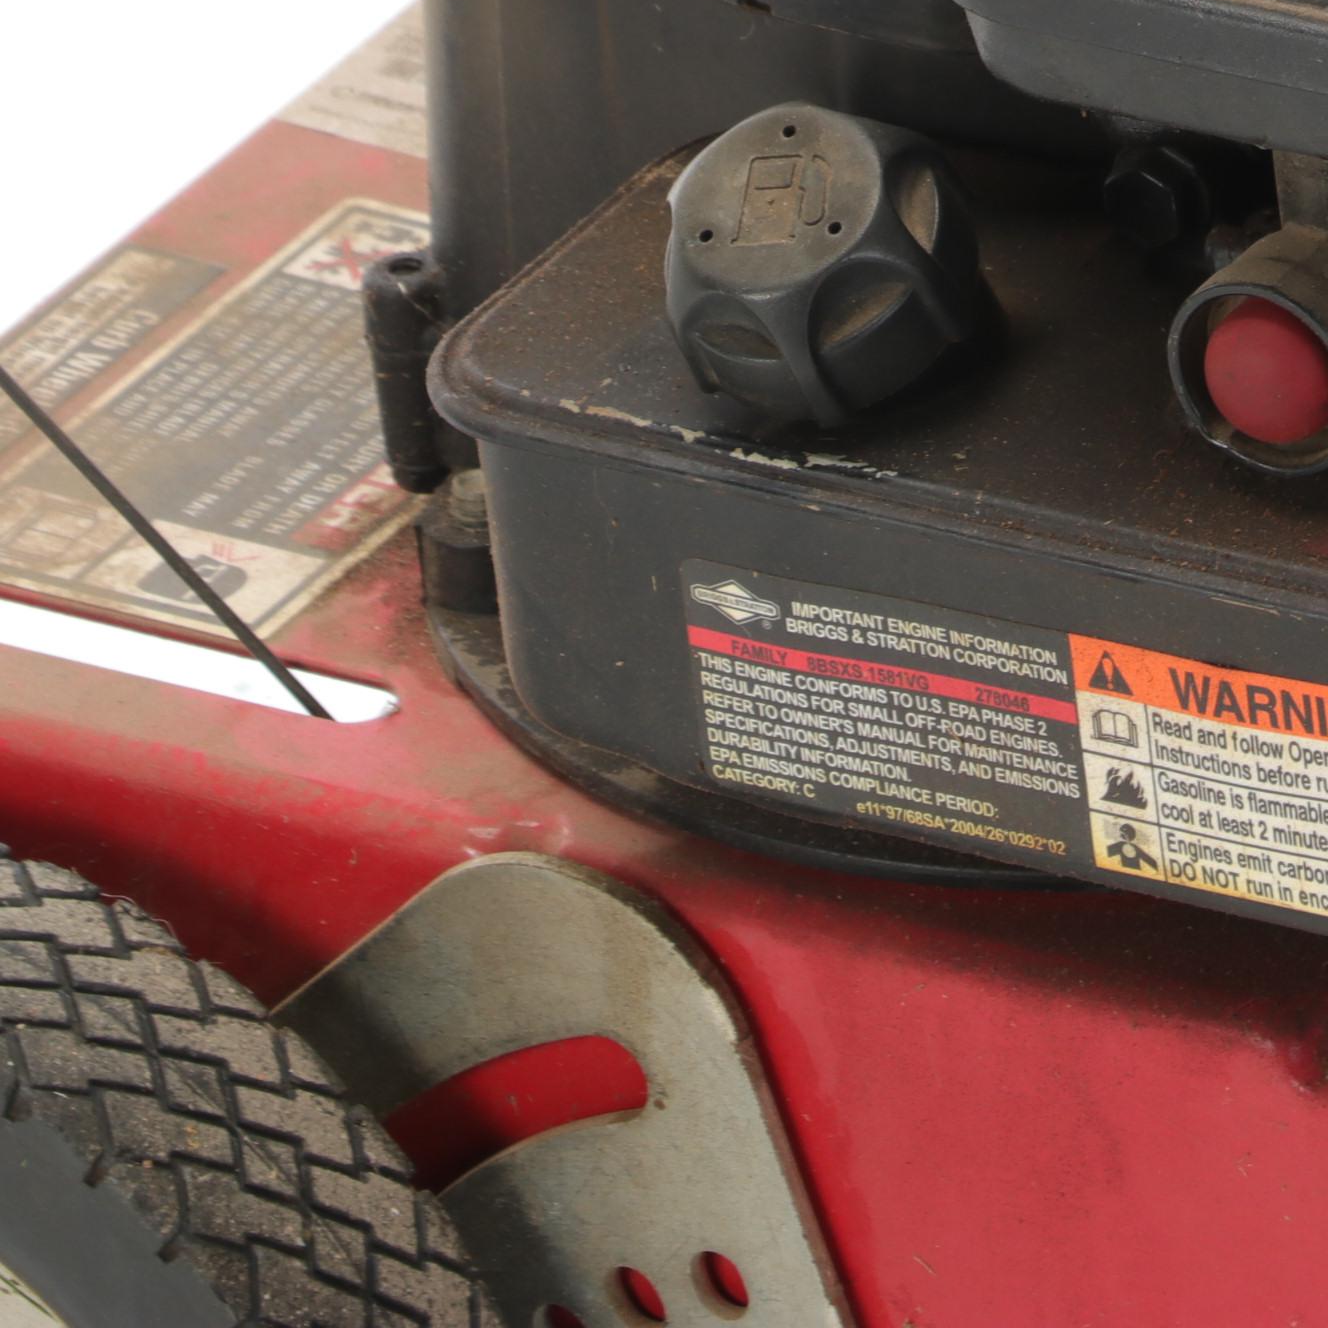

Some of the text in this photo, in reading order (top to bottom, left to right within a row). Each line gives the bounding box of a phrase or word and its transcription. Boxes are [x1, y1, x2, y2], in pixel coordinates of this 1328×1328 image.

[276, 461, 321, 493] AWAY
[263, 494, 323, 535] DEATH
[730, 640, 788, 665] FAMILY
[785, 616, 1068, 683] BRIGGS & STRATTON CORPORATION
[790, 600, 1057, 665] IMPORTANT ENGINE INFORMATION
[700, 652, 1047, 736] THIS ENGINE CONFORMS TO U.S. EPA PHASE 2
[700, 673, 1062, 756] REGULATIONS FOR SMALL OFF-ROAD ENGINES.
[702, 690, 1077, 777] REFER TO OWNER'S MANUAL FOR MAINTENANCE
[704, 711, 1080, 798] SPECIFICATIONS, ADJUSTMENTS, AND EMISSIONS
[706, 728, 912, 781] DURABILITY INFORMATION.
[1150, 711, 1192, 741] Read
[1196, 727, 1226, 749] and
[1230, 730, 1284, 759] follow
[709, 746, 999, 818] EPA EMISSIONS COMPLIANCE PERIOD:
[711, 765, 816, 798] CATEGORY: C
[1154, 744, 1251, 779] Instructions
[1255, 764, 1311, 790] before
[1156, 771, 1226, 805] Gasoline
[1228, 788, 1244, 810] is
[1159, 802, 1194, 824] cool
[1197, 809, 1214, 829] at
[1216, 811, 1255, 837] least
[1257, 820, 1269, 840] 2
[1165, 833, 1233, 865] Engines
[1236, 851, 1273, 874] emit
[1168, 858, 1196, 882] DO
[1200, 865, 1240, 891] NOT
[1245, 877, 1274, 899] run
[1276, 880, 1291, 902] in
